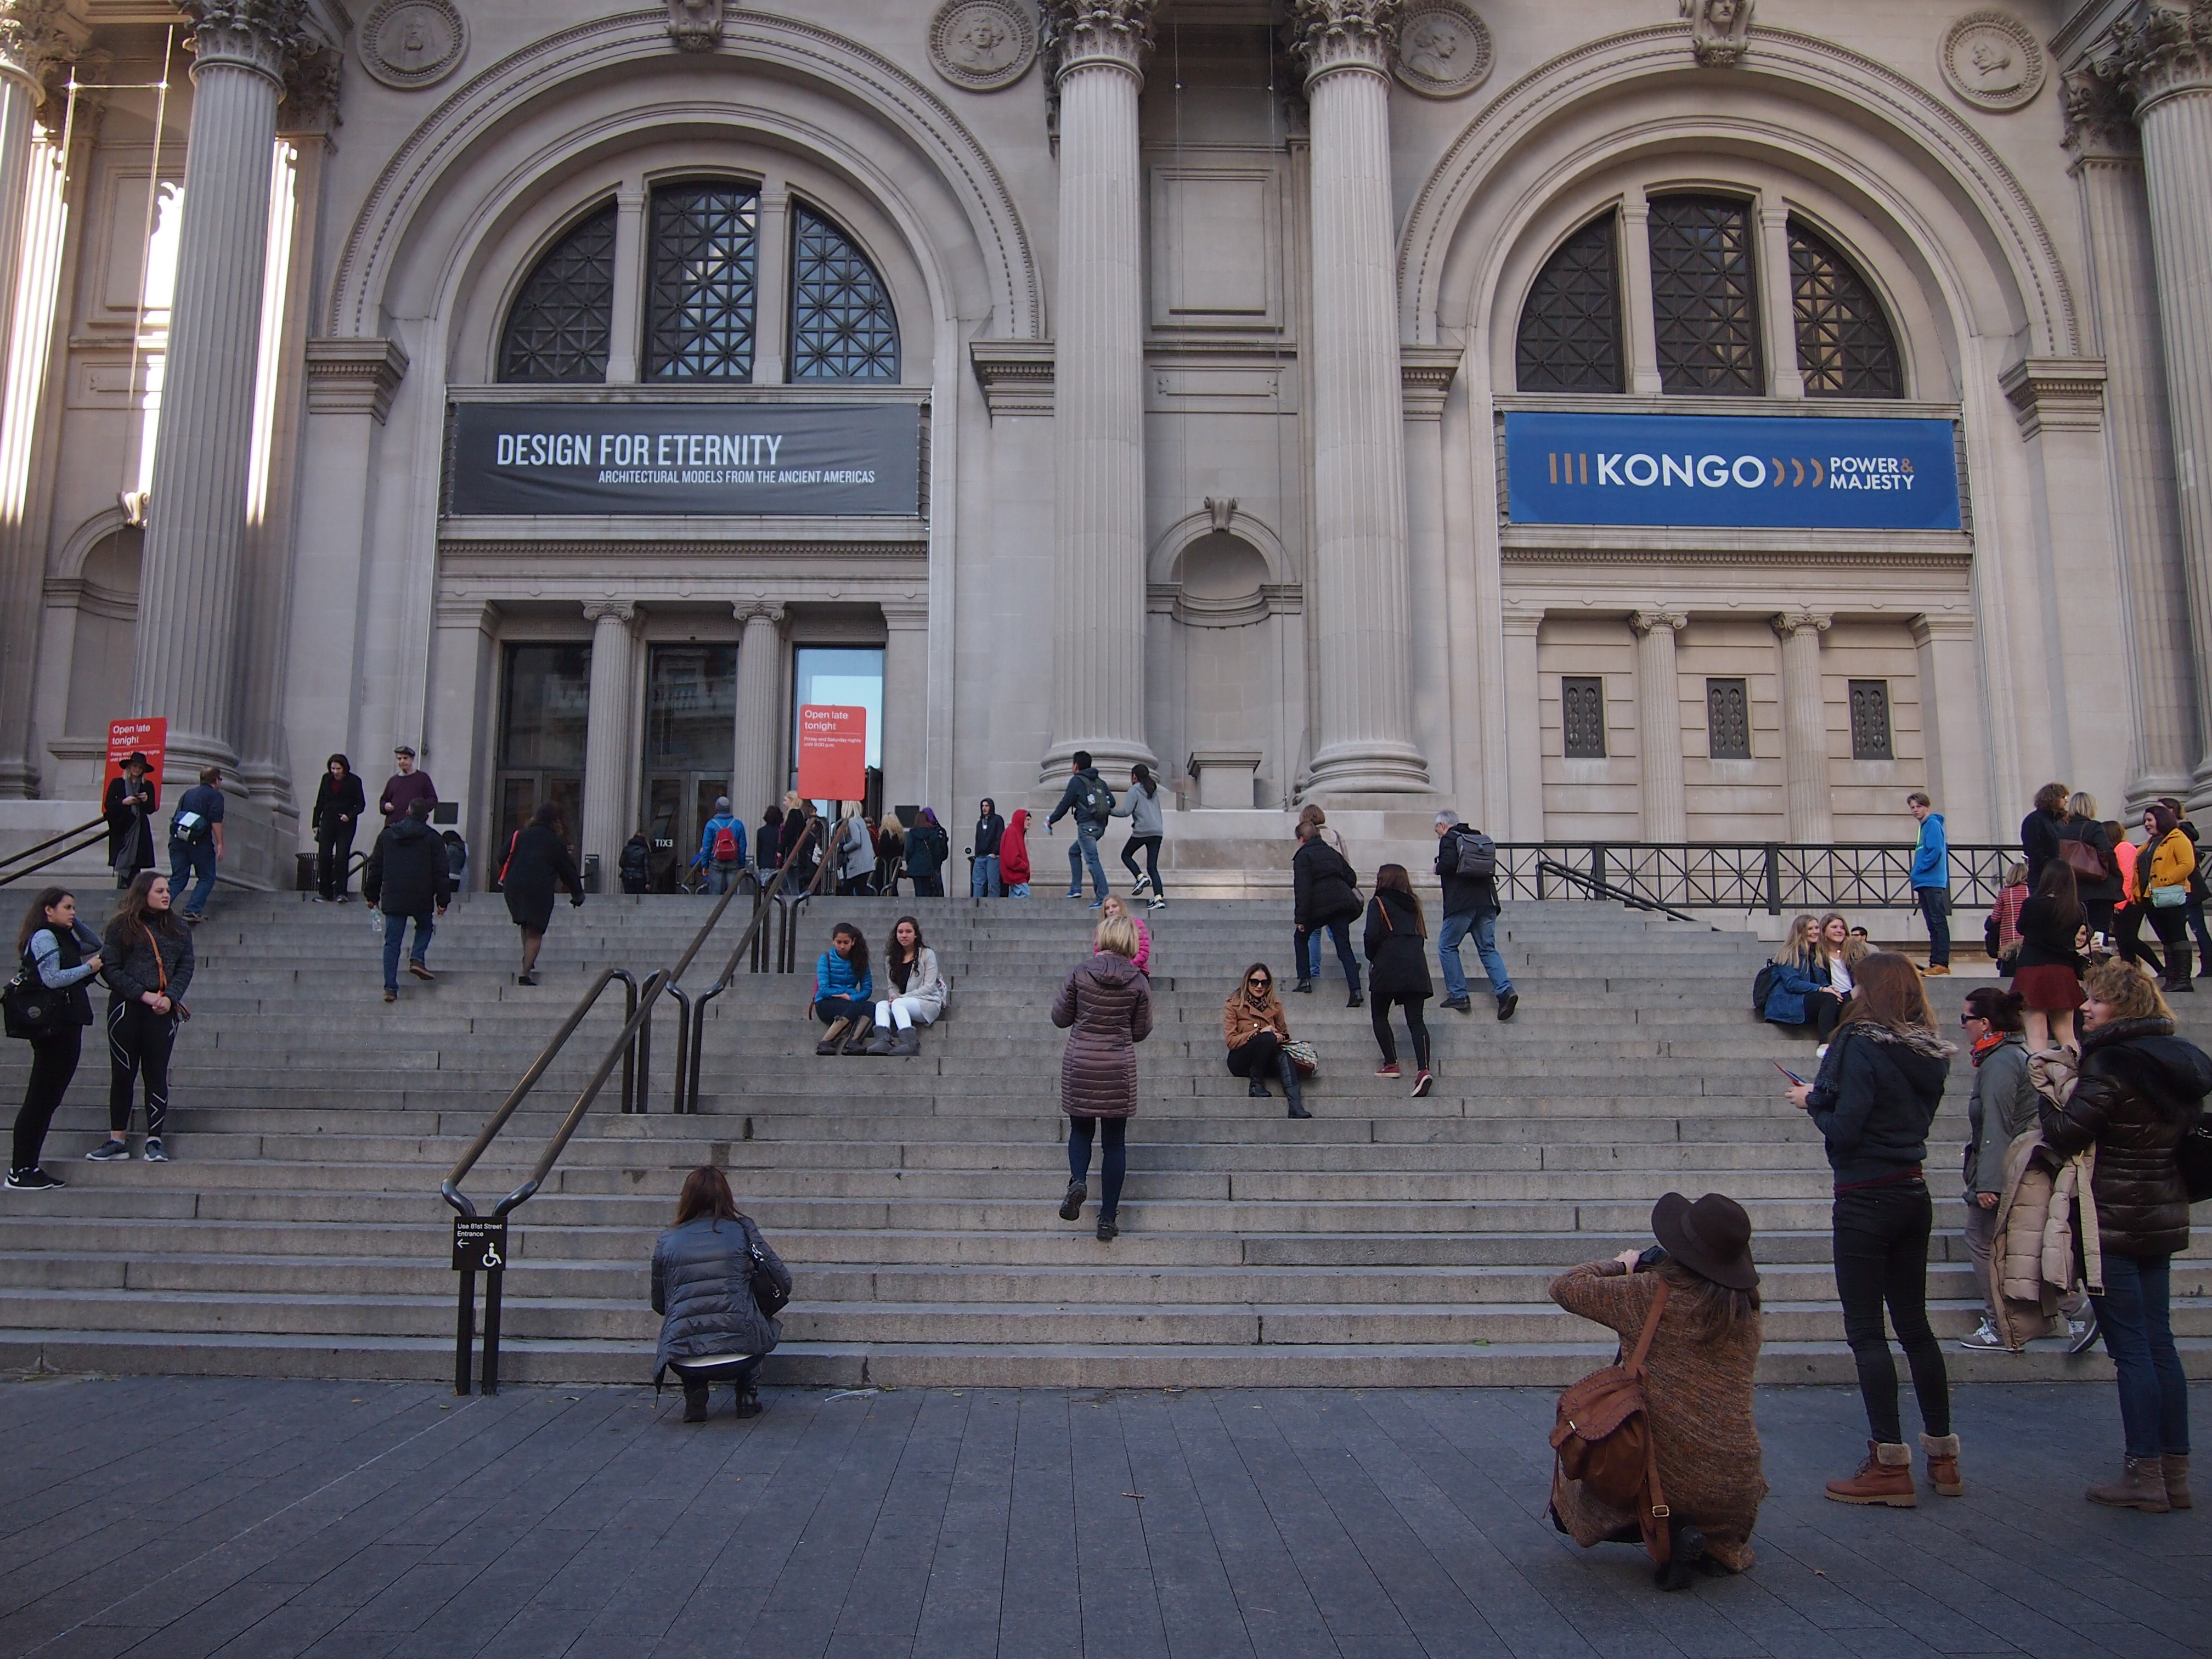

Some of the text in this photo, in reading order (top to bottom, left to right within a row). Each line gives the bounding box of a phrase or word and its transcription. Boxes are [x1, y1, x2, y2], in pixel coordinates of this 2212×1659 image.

[497, 434, 782, 465] DESIGN FOR ETERNITY
[599, 470, 875, 483] ARCHITECTURAL MODELS FROM THE ANCIENT AMERICAS
[1597, 453, 1766, 488] KONGO
[1830, 474, 1914, 490] MAJESTY
[805, 710, 848, 720] Open late
[113, 724, 151, 735] Open late
[805, 722, 837, 731] tonight
[112, 736, 139, 746] tonight
